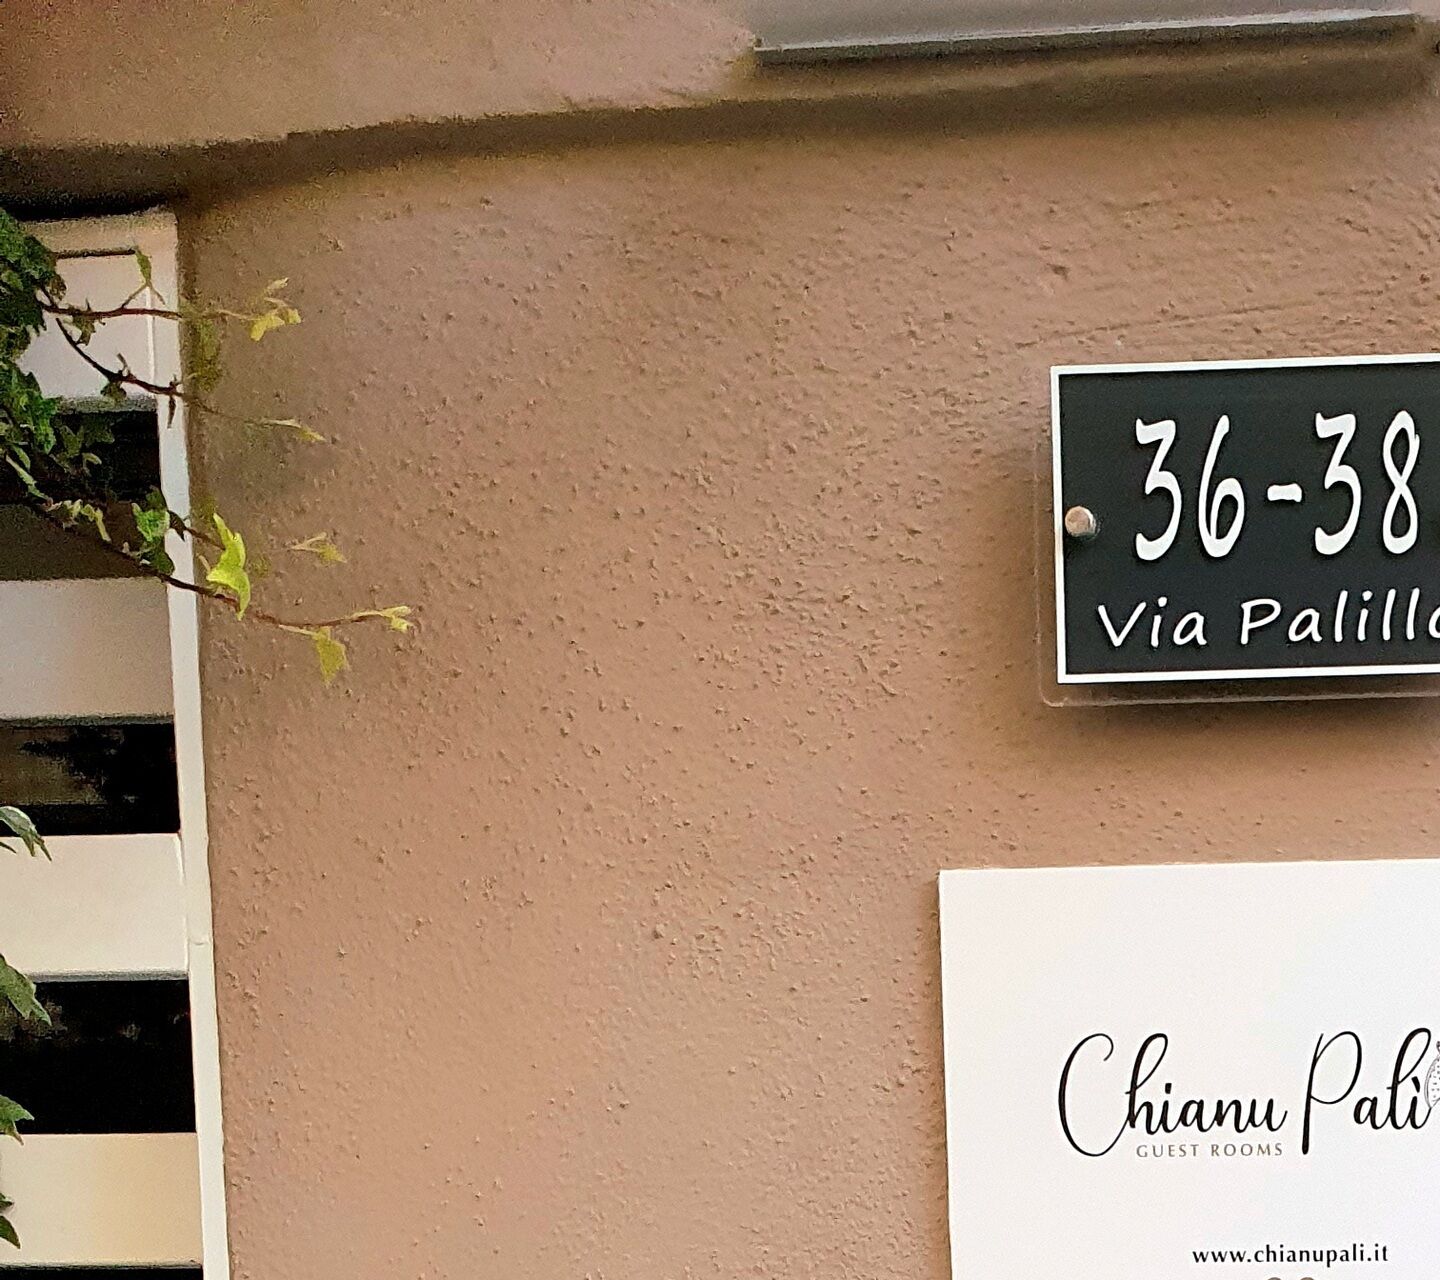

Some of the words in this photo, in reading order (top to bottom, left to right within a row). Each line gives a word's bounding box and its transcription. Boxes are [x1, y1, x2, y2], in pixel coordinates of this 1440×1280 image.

[1135, 410, 1421, 561] 36-38
[1097, 596, 1208, 648] Via
[1058, 1027, 1288, 1158] Chianu
[1301, 1027, 1433, 1156] Palì
[1136, 1143, 1200, 1158] GUEST
[1211, 1142, 1284, 1158] ROOMS
[1191, 1243, 1389, 1268] www.chianupali.it
